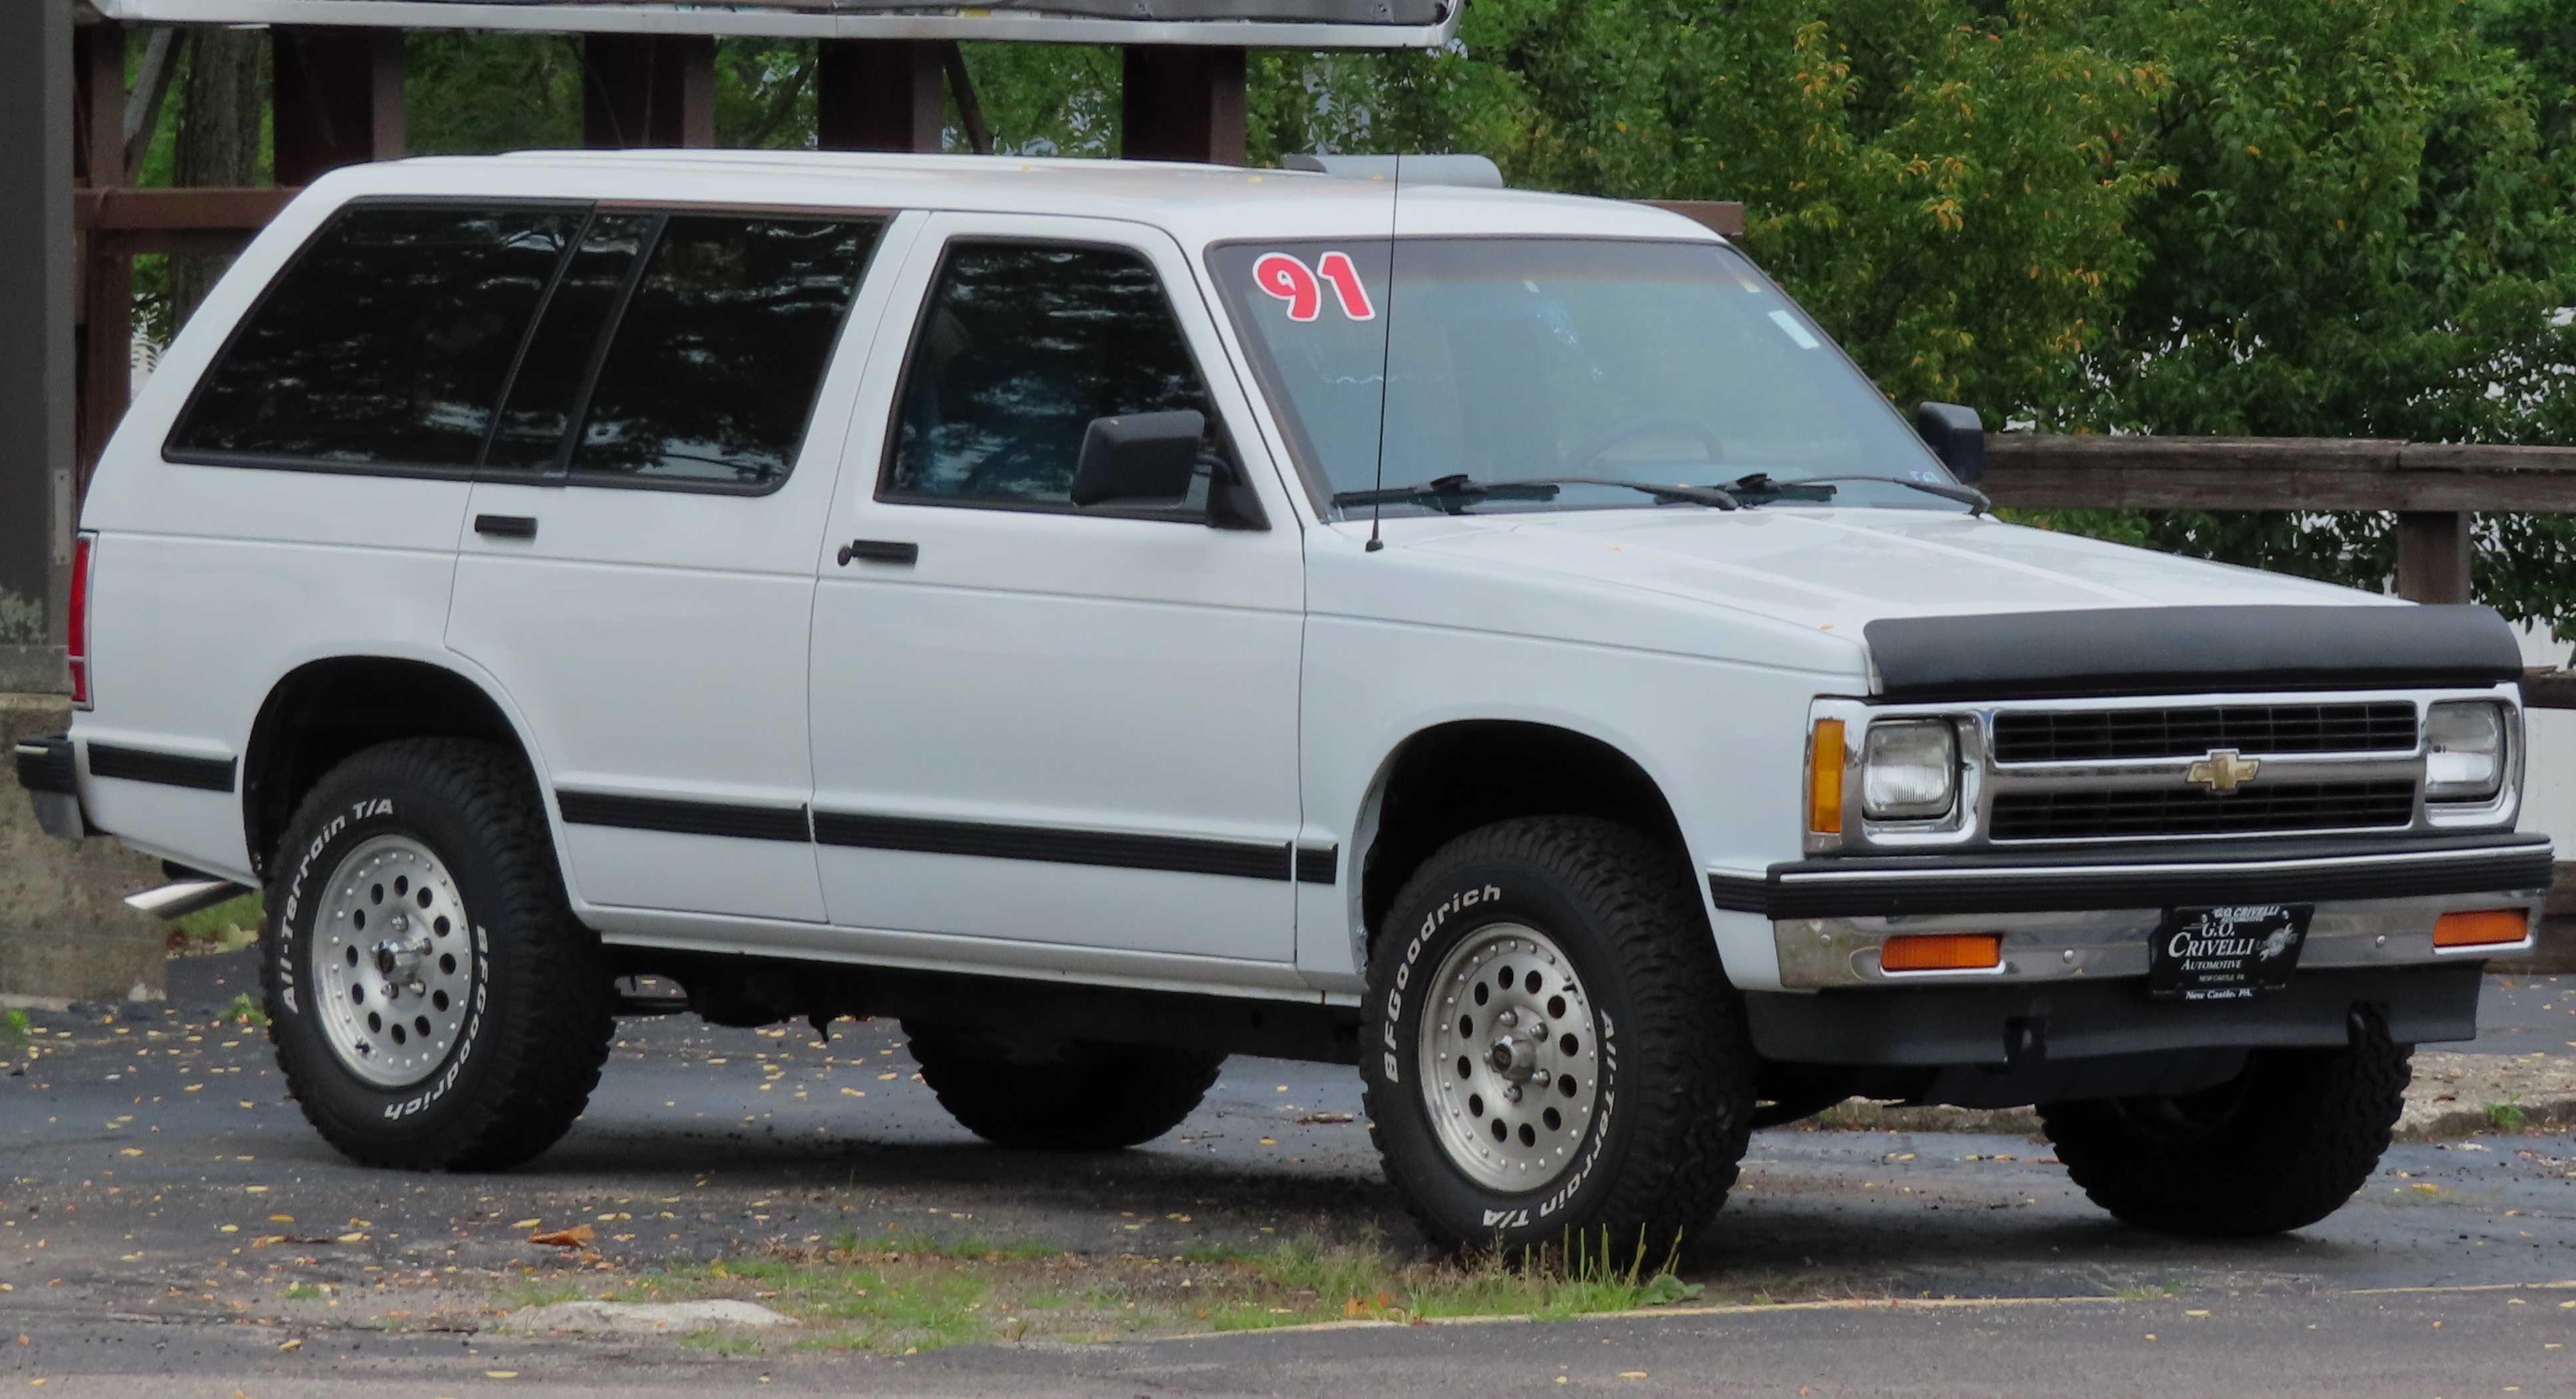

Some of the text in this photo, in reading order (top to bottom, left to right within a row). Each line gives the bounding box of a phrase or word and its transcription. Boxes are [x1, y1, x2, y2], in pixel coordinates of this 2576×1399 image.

[1253, 250, 1376, 322] 91
[280, 797, 394, 1015] All-Terrain T/A
[2233, 905, 2280, 917] CRIVELLI
[2168, 932, 2255, 957] CRIVELLI
[2202, 923, 2235, 938] G.O.
[1383, 883, 1501, 1084] BFGoodrich
[2180, 959, 2242, 971] AUTOMOTIVE
[2186, 991, 2206, 999] New
[384, 925, 489, 1121] BFGoodrich
[1482, 1008, 1618, 1228] All-Terrain T/A
